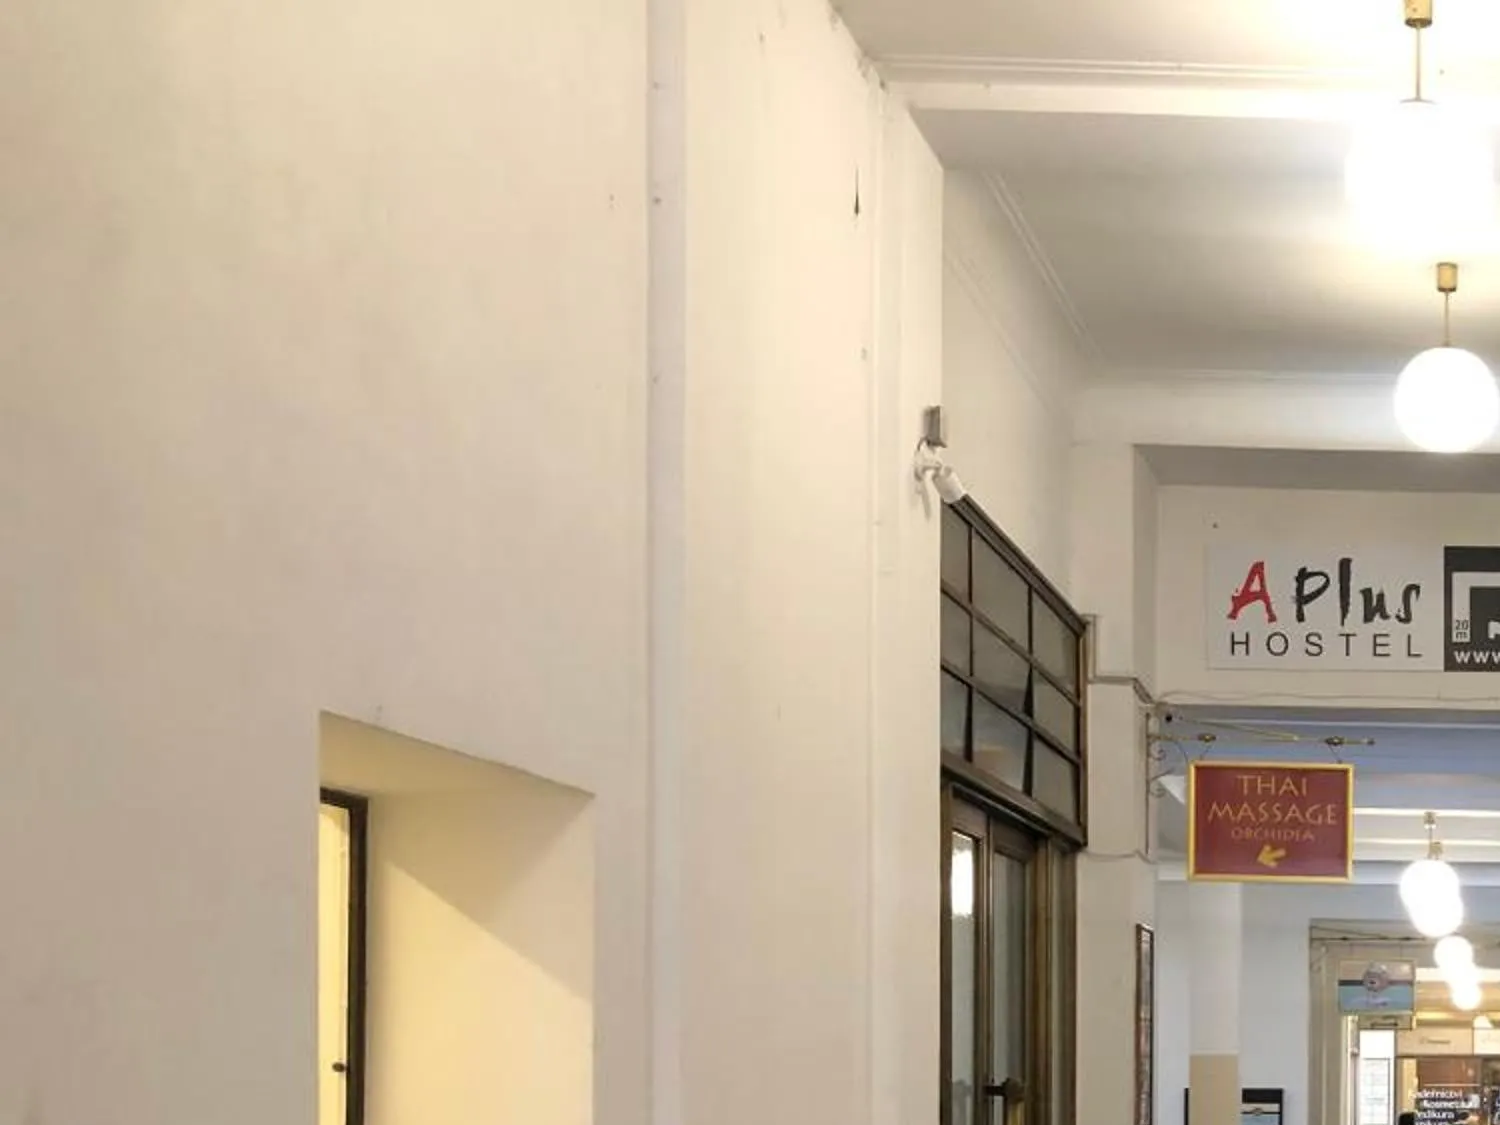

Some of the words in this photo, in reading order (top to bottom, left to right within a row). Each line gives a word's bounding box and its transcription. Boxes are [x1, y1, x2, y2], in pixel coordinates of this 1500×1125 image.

[1455, 620, 1469, 630] 20
[1231, 631, 1423, 657] HOSTEL
[1237, 775, 1307, 797] THAI
[1208, 801, 1338, 825] MASSAGE
